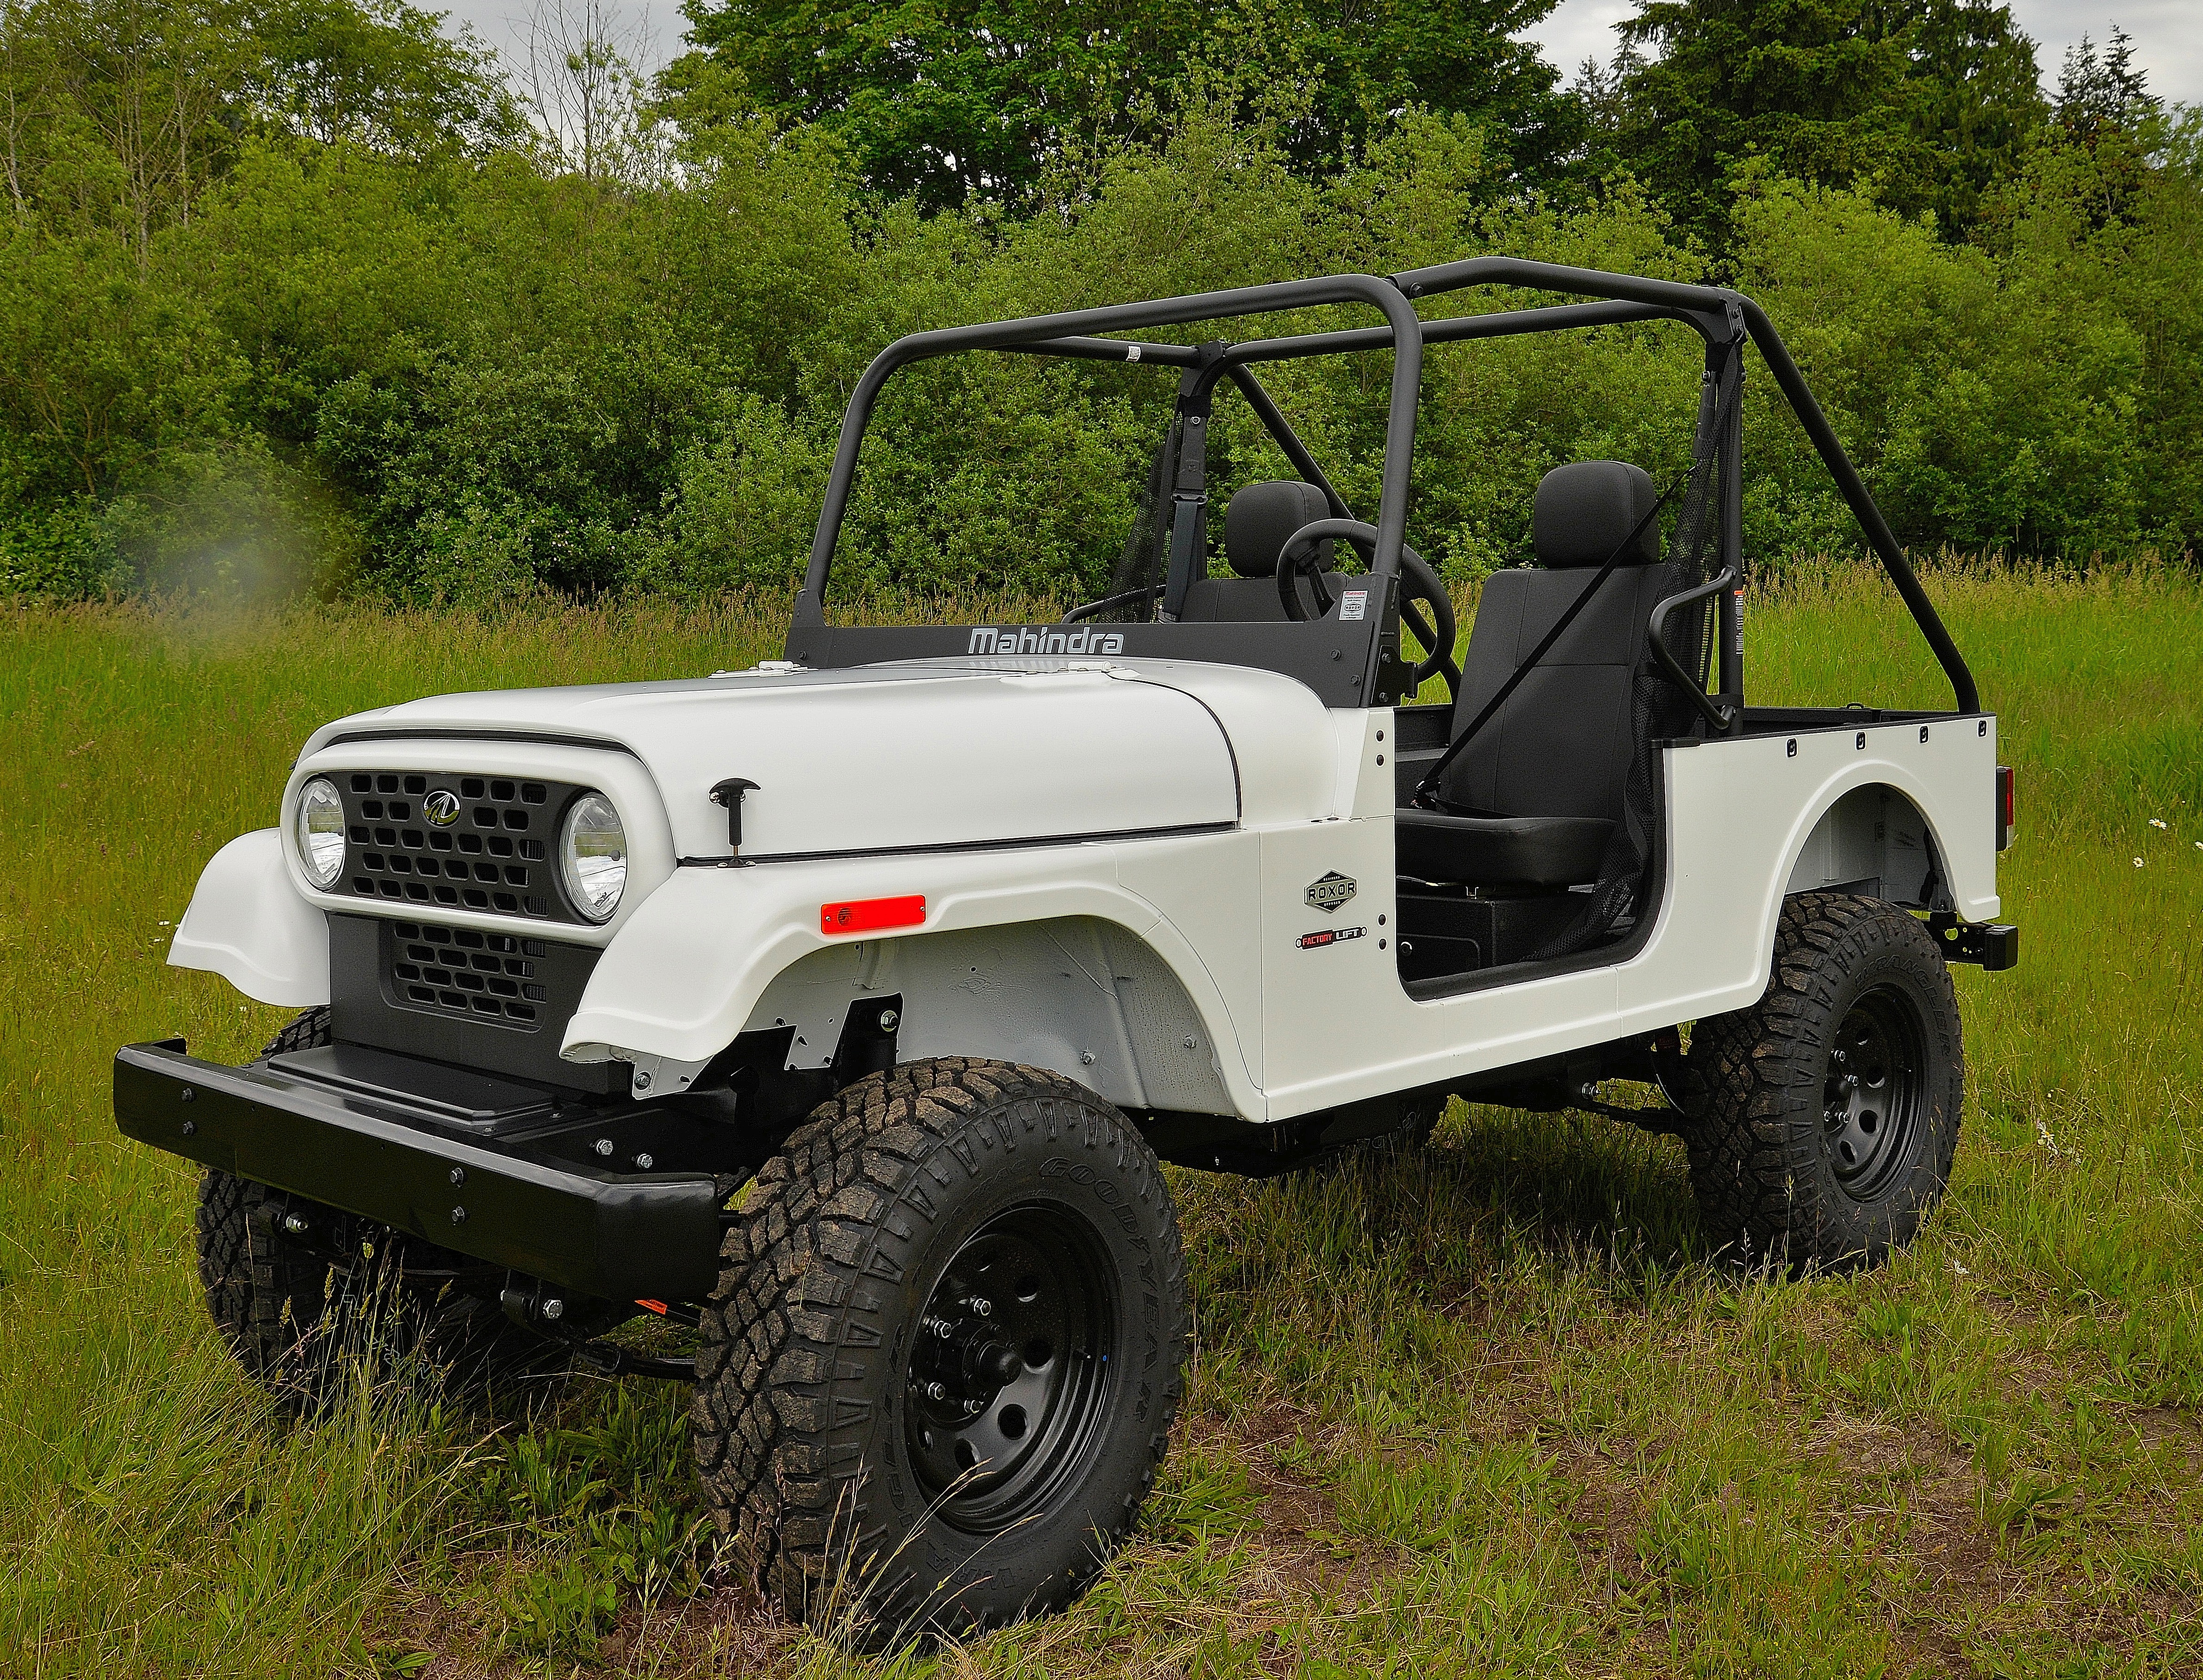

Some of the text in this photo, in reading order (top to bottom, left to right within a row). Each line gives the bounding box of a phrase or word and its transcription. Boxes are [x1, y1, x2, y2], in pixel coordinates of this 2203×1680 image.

[968, 626, 1124, 654] Mahindra
[1308, 881, 1355, 901] ROXOR
[1303, 928, 1359, 946] FACTORY LIFT
[1855, 955, 1951, 1056] WRANGLER
[1038, 1156, 1159, 1423] GOODYEAR
